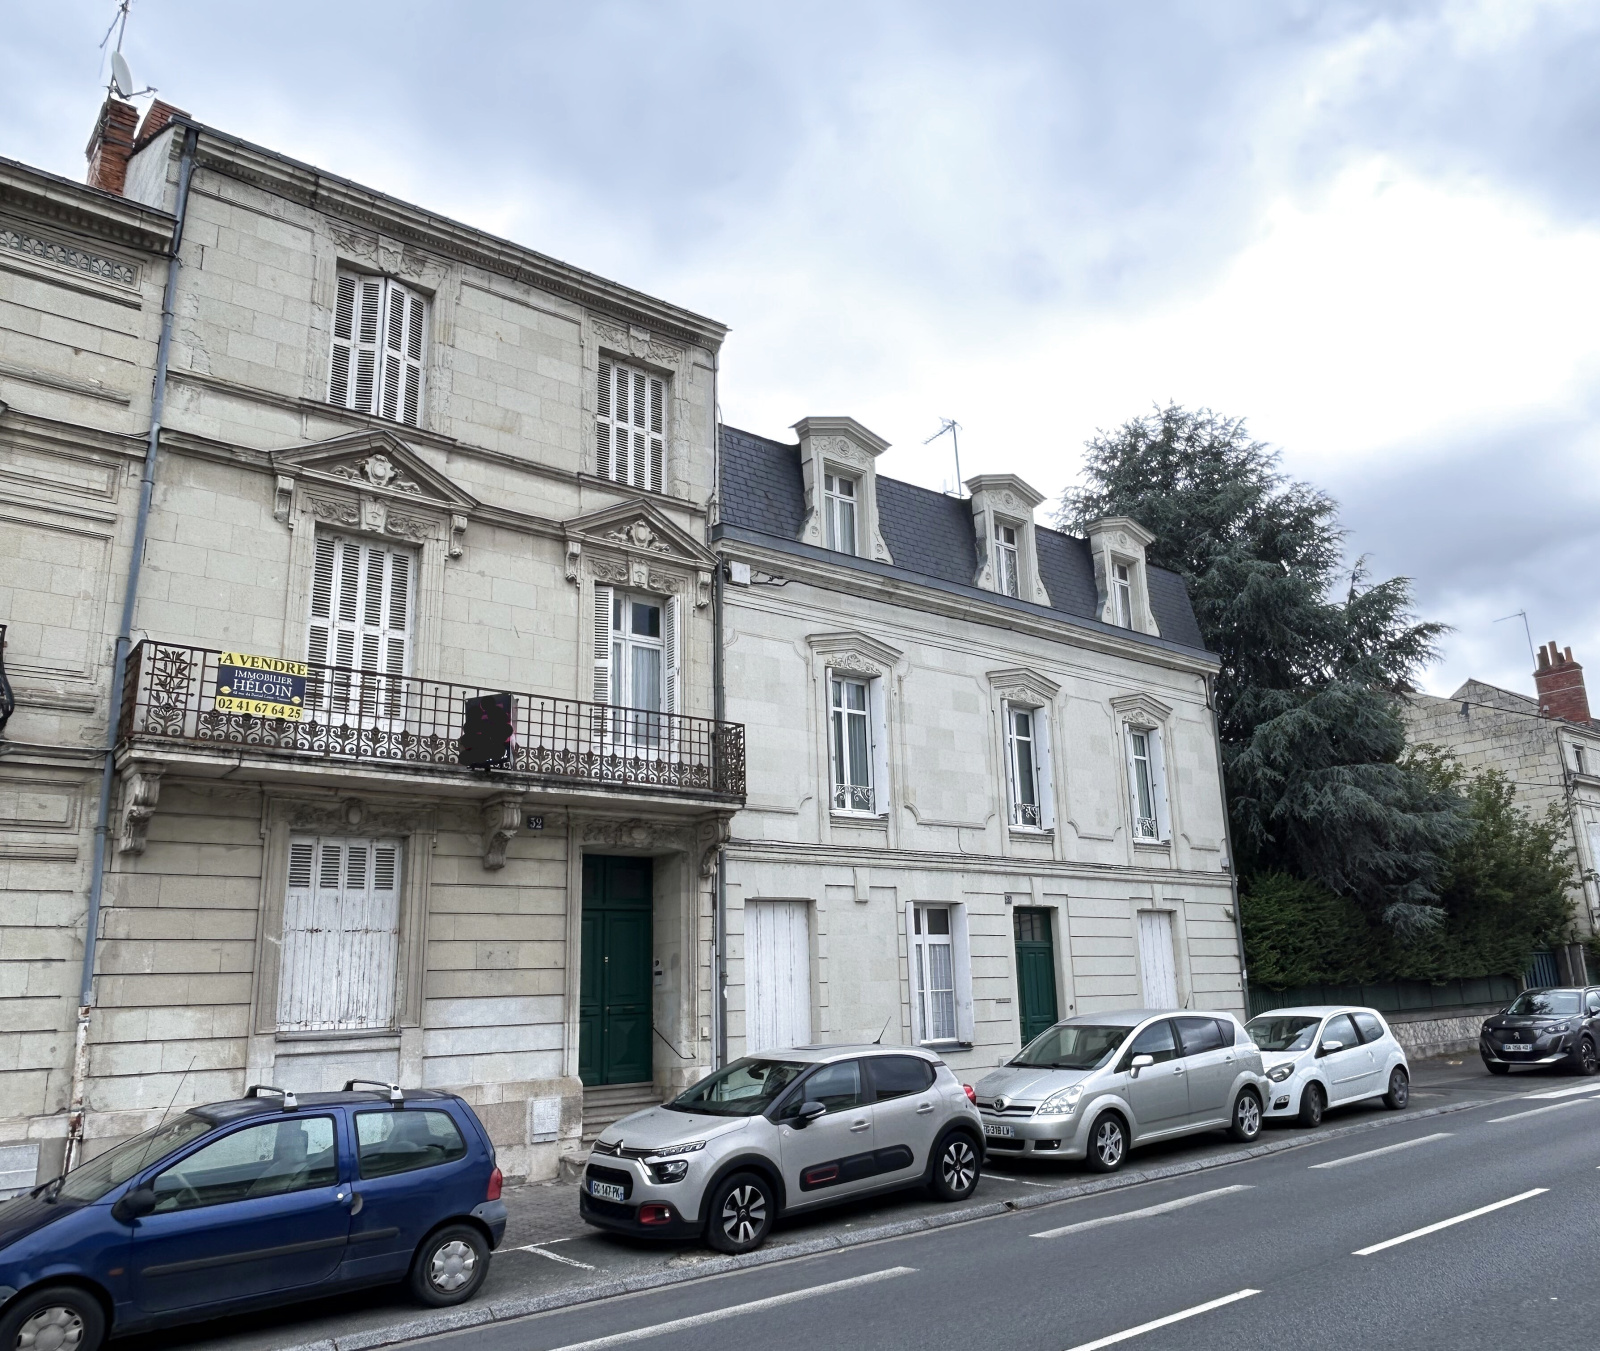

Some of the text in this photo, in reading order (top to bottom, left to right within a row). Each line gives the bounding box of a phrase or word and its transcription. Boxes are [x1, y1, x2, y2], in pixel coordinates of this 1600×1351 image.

[222, 653, 306, 676] A VENDRE
[234, 669, 293, 686] IMMOBILIER
[232, 678, 293, 698] HÉLOIN
[218, 698, 301, 719] 02 41 67 64 25
